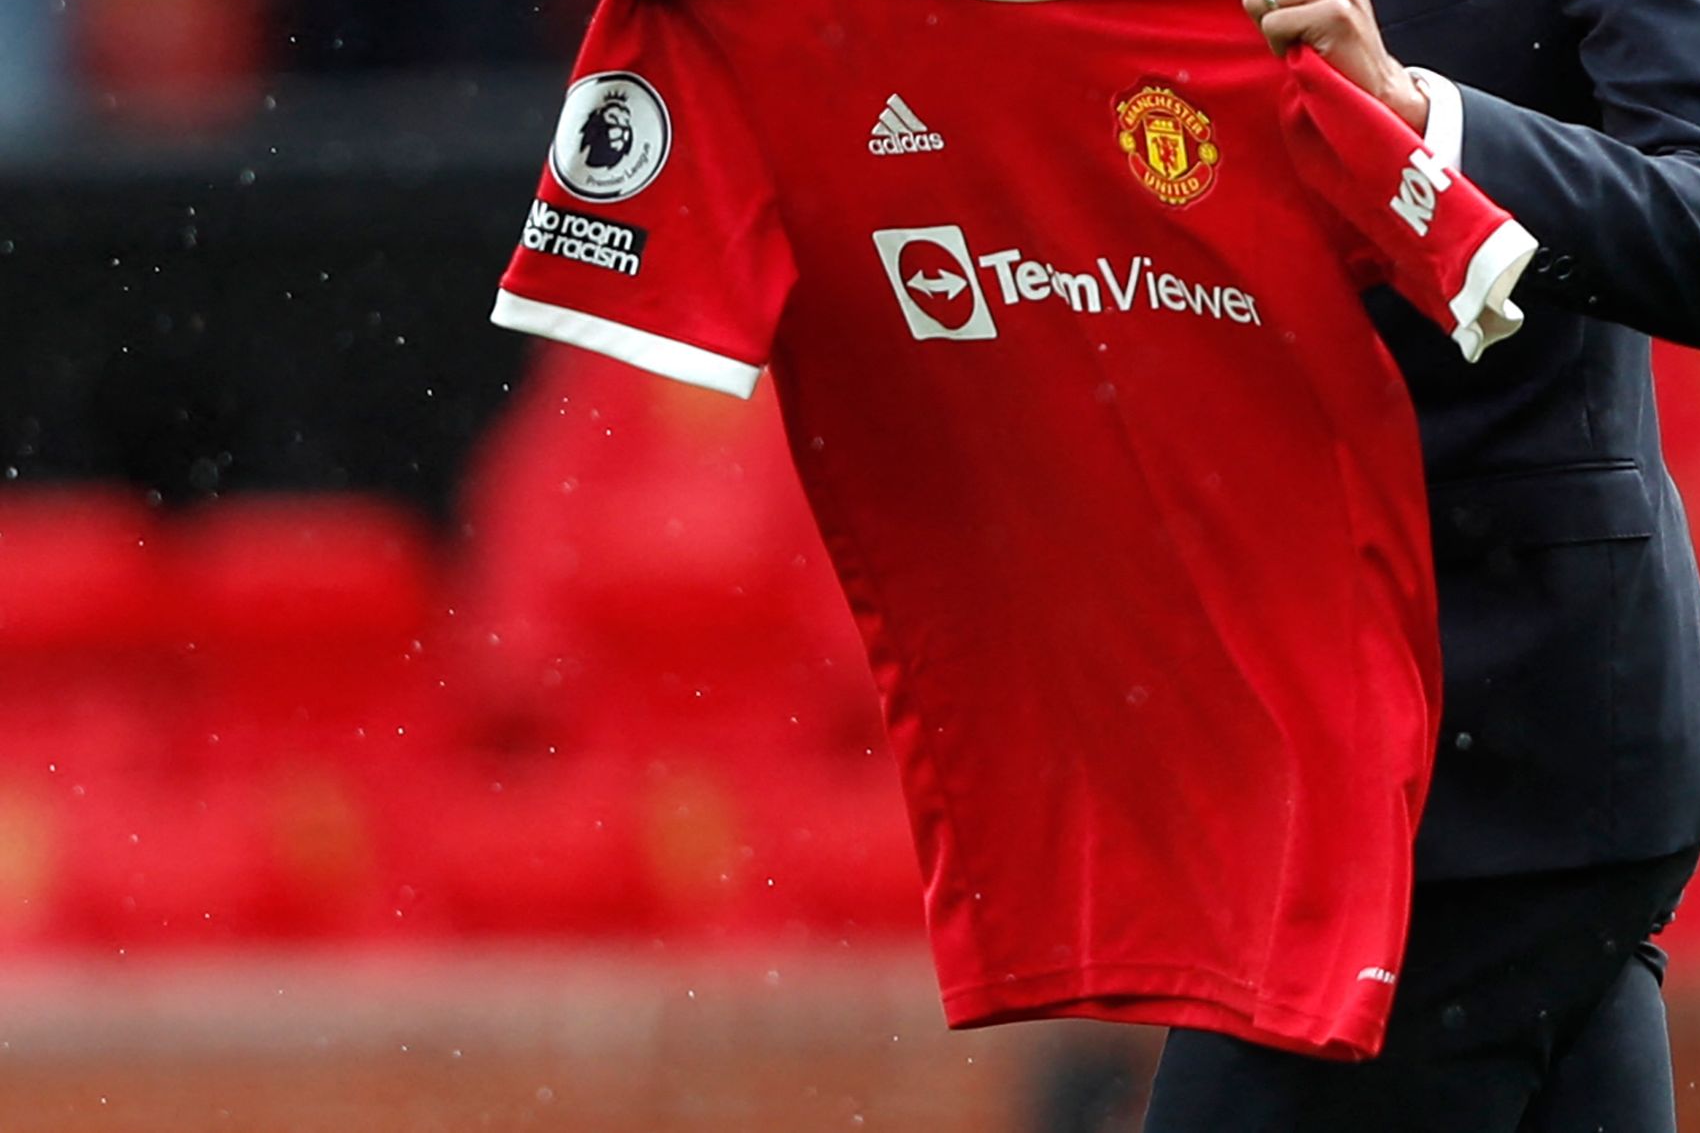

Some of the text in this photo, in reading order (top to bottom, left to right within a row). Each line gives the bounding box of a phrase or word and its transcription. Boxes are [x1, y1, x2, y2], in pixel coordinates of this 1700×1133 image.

[1124, 95, 1204, 136] MANCHESTER
[868, 132, 945, 156] adidas
[1144, 170, 1201, 197] UNITED
[525, 198, 633, 251] No room
[523, 220, 640, 276] or racism
